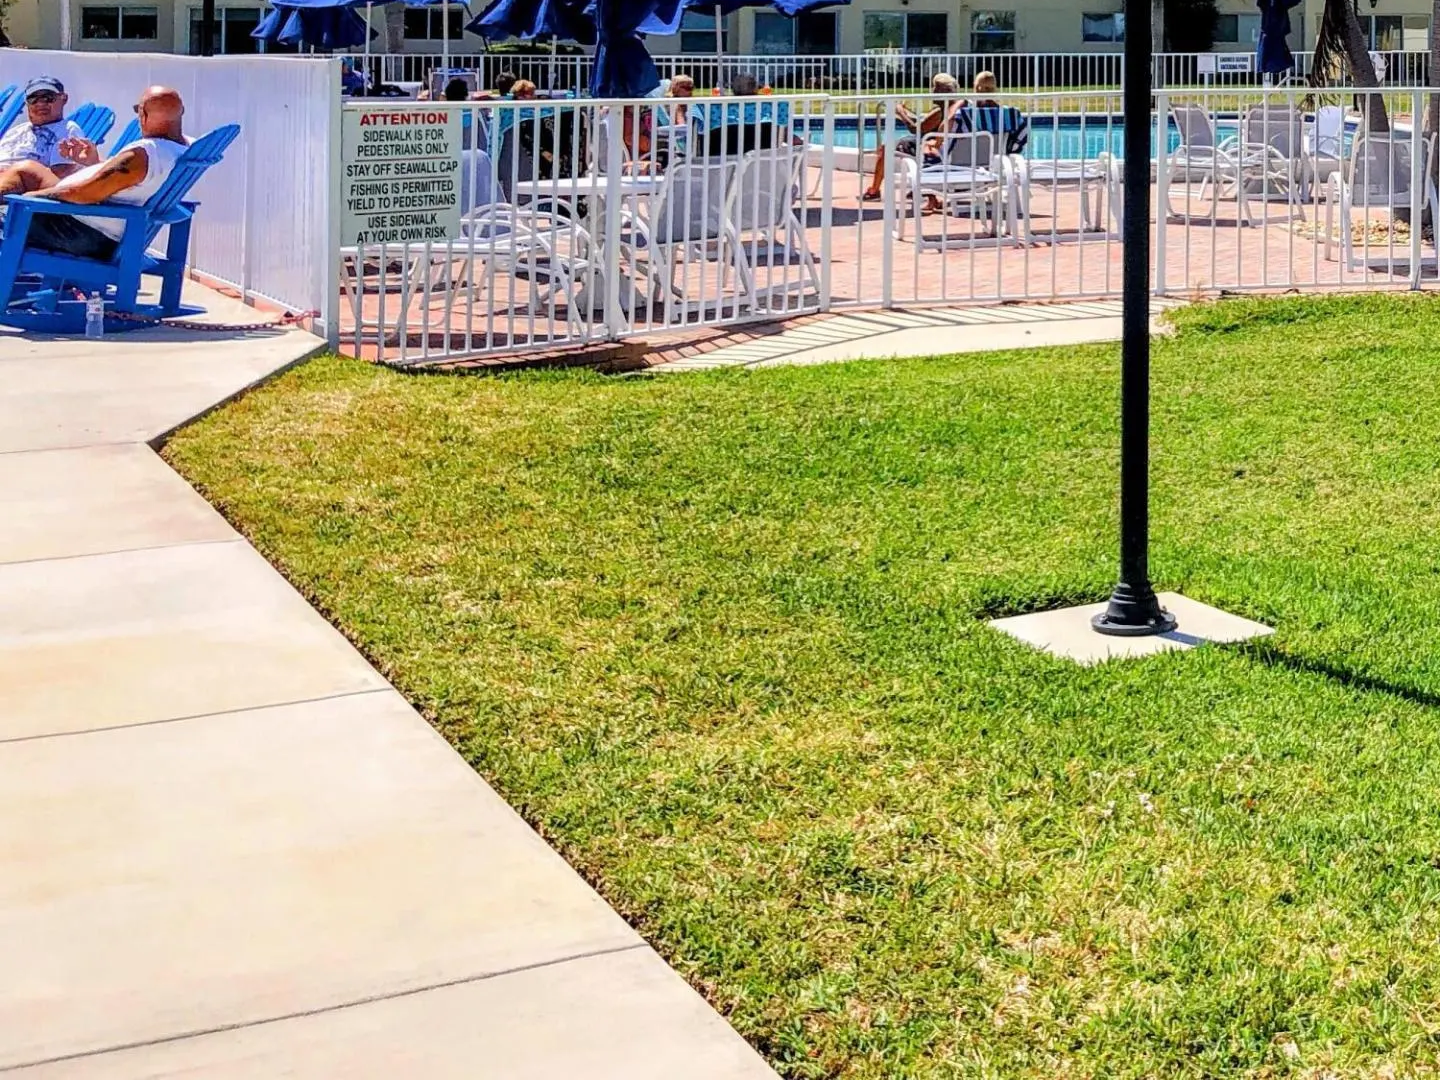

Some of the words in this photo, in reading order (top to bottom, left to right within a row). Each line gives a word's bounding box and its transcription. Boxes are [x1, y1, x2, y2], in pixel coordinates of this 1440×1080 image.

[360, 113, 448, 126] ATTENTION
[363, 130, 411, 142] SIDEWALK
[415, 129, 423, 140] IS
[426, 129, 444, 140] FOR
[358, 144, 423, 157] PEDESTRIANS
[426, 143, 449, 154] ONLY
[347, 165, 370, 176] STAY
[373, 164, 391, 175] OFF
[394, 162, 437, 175] SEAWALL
[440, 161, 458, 171] CAP
[351, 183, 388, 196] FISHING
[391, 183, 400, 193] IS
[403, 180, 453, 193] PERMITTED
[347, 198, 375, 210] YIELD
[378, 197, 390, 209] TO
[393, 194, 456, 208] PEDESTRIANS
[368, 216, 386, 228] USE
[390, 213, 437, 226] SIDEWALK
[357, 232, 369, 243] AT
[372, 230, 397, 242] YOUR
[401, 229, 422, 240] OWN
[425, 227, 446, 238] RISK
